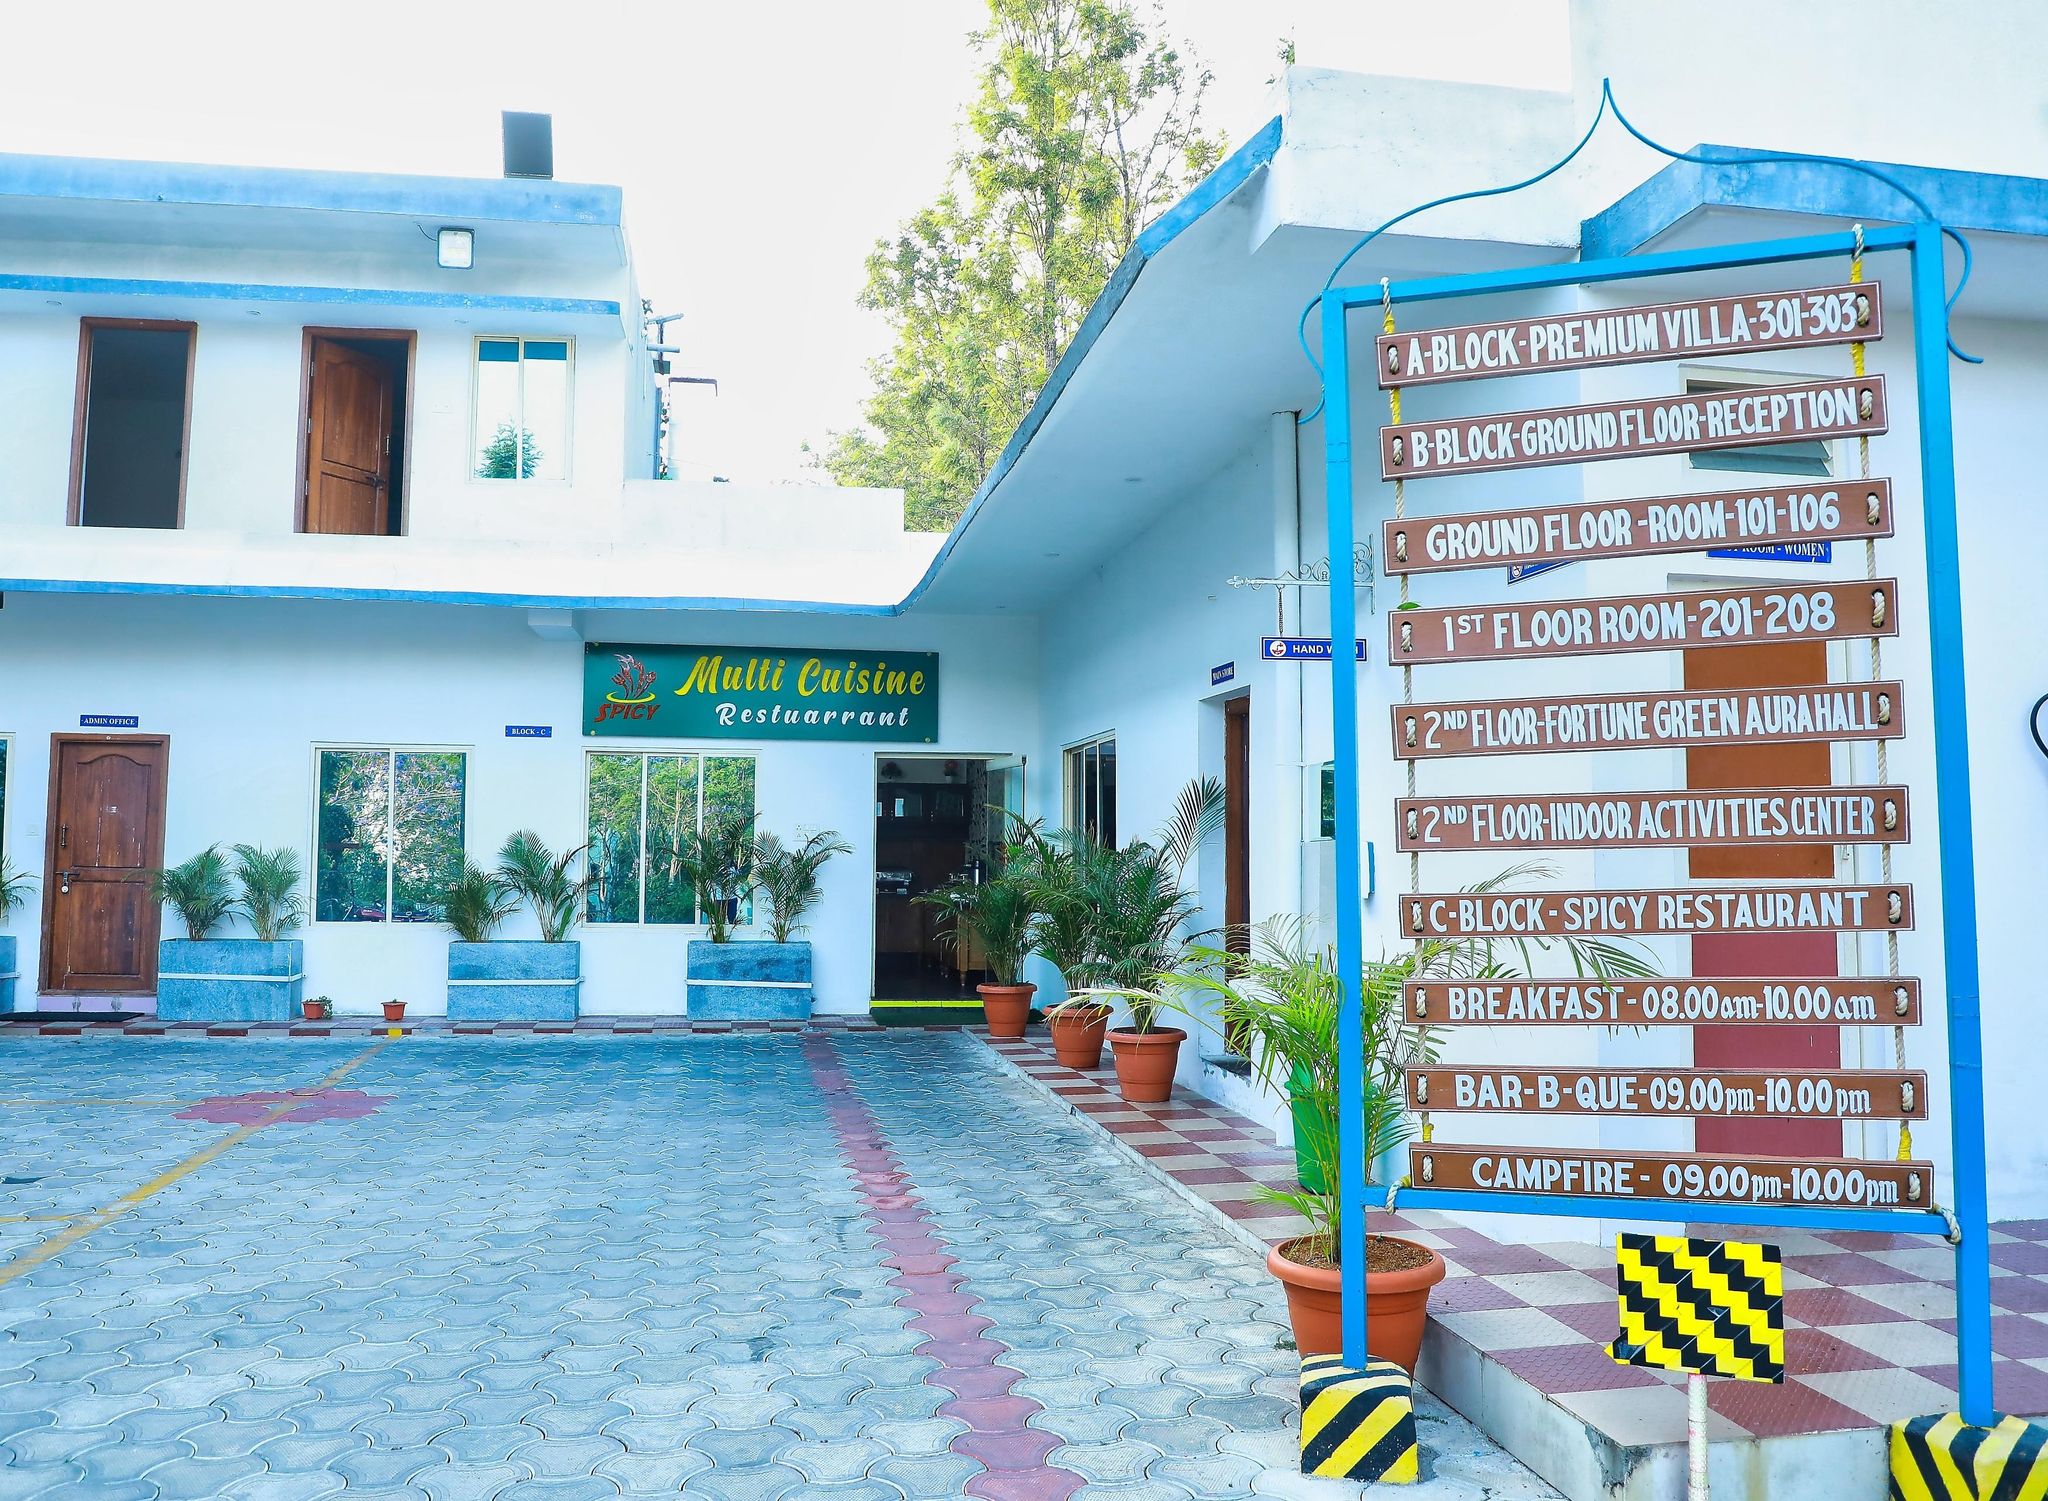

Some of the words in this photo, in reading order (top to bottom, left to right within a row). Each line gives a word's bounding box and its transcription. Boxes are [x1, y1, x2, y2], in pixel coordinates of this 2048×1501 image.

[1426, 516, 1539, 561] GROUND
[1543, 509, 1632, 552] FLOOR
[1784, 542, 1825, 557] WOMEN
[1443, 614, 1484, 651] 1ST
[1493, 608, 1593, 649] FLOOR
[1293, 645, 1323, 654] HAND
[674, 656, 785, 696] Multi
[797, 658, 925, 696] Cuisine
[594, 703, 661, 723] SPICY
[715, 702, 909, 727] Restuarrant
[1424, 710, 1468, 748] 2ND
[1653, 697, 1740, 738] GREEN
[1422, 805, 1468, 843] 2ND
[1638, 797, 1788, 839] ACTIVITIES
[1790, 797, 1875, 836] CENTER
[1658, 891, 1869, 929] RESTAURANT
